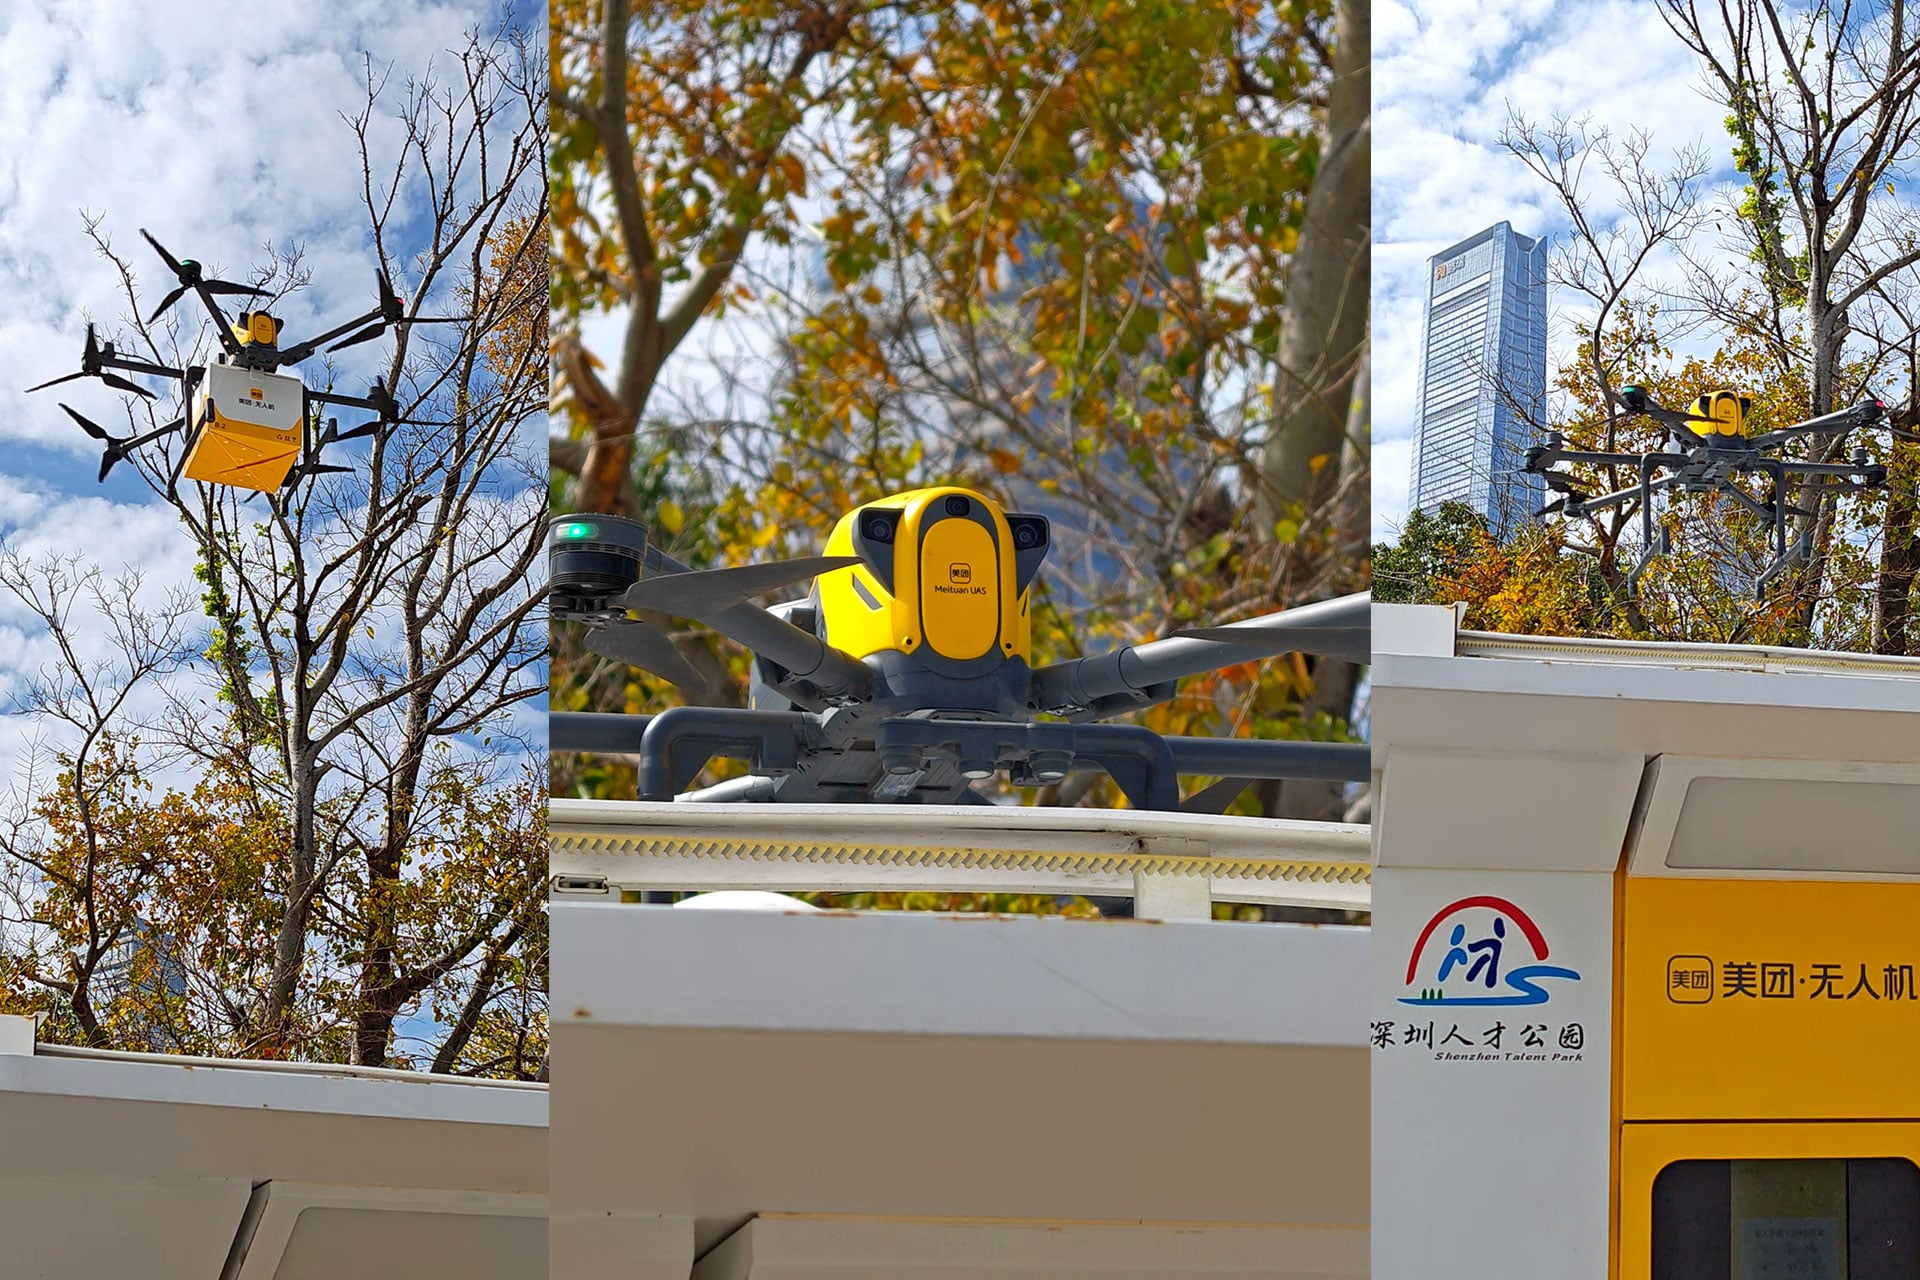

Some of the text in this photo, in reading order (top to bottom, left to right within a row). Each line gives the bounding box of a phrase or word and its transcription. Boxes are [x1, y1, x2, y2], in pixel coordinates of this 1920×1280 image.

[952, 569, 969, 578] 美团
[934, 585, 987, 595] Meituan UAS
[1672, 961, 1918, 1001] 美团 美团·无人机
[1371, 1021, 1584, 1050] 深圳人才公园
[1434, 1052, 1583, 1061] Shenzhen Talent Park
